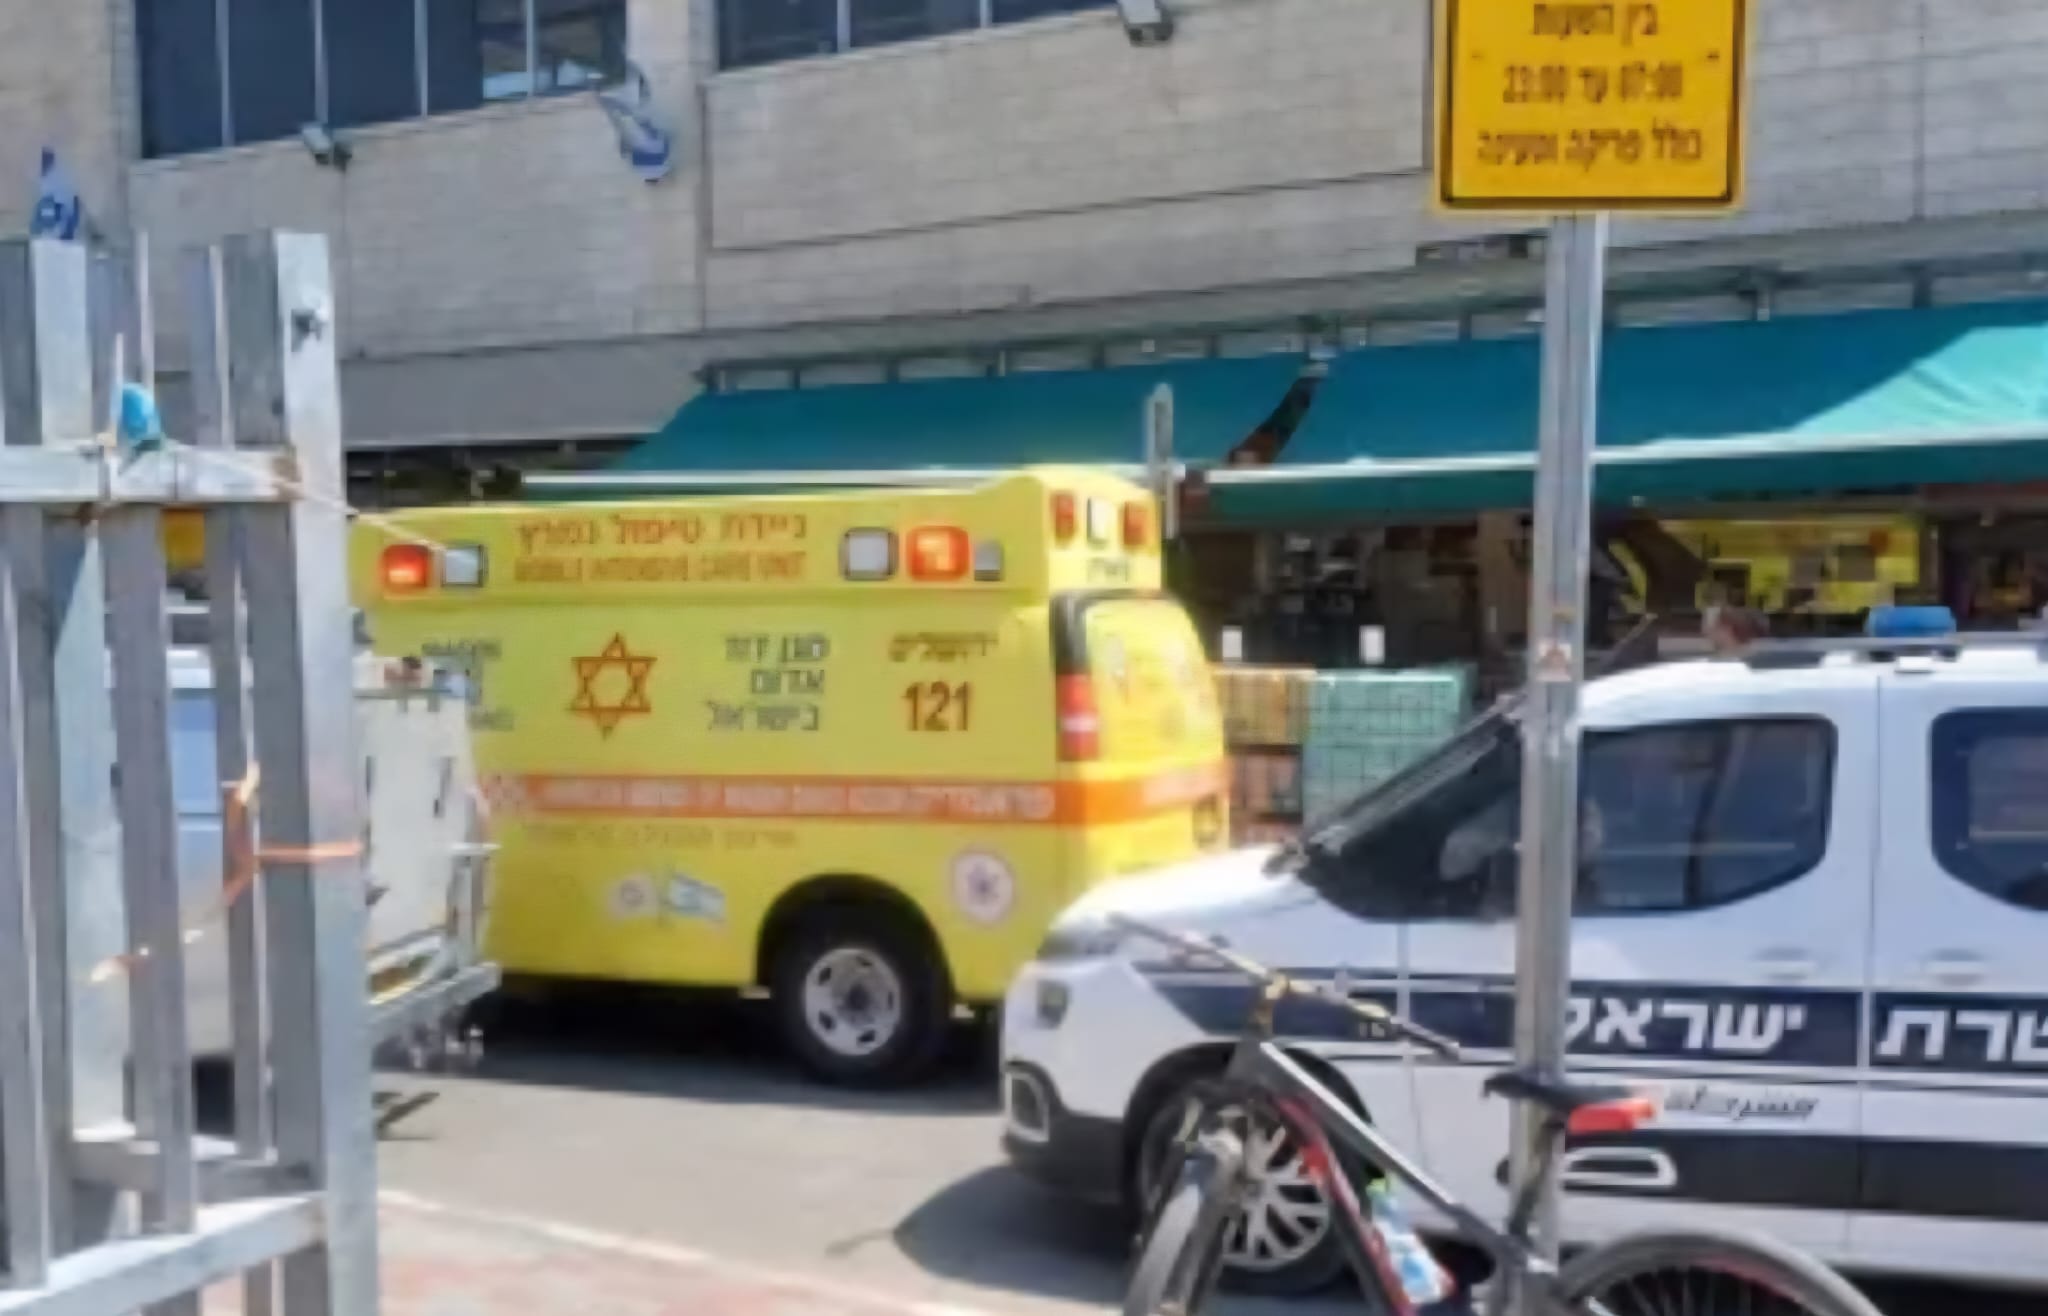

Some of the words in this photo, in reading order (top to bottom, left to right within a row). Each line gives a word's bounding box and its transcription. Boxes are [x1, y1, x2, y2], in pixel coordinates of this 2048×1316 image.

[1622, 3, 1657, 46] בין
[1578, 66, 1608, 103] עד
[1565, 128, 1641, 172] פריקה
[613, 512, 702, 545] טיפול
[724, 634, 769, 662] דוד
[780, 632, 831, 662] מגן
[750, 668, 825, 695] אדום
[705, 699, 819, 731] בישראל
[904, 680, 970, 732] 121
